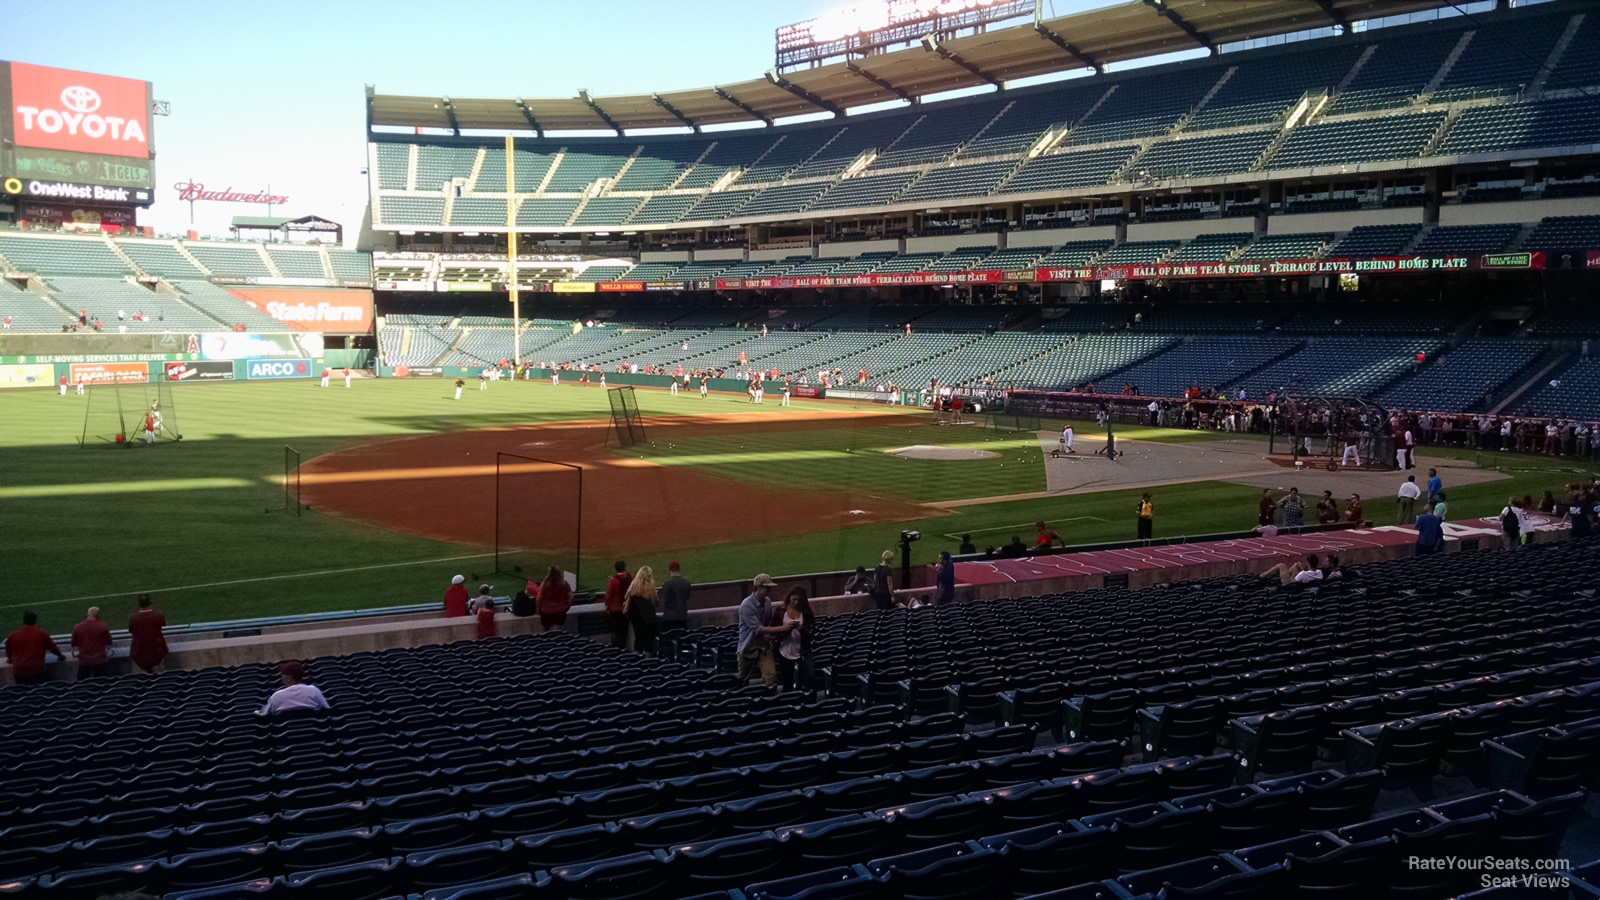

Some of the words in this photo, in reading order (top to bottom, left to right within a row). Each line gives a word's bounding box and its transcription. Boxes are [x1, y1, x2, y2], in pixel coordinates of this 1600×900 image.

[17, 106, 145, 142] TOYOTA
[29, 181, 92, 198] OneWest
[94, 185, 128, 201] Bank
[174, 182, 289, 204] Budweiser
[1049, 269, 1072, 278] VISIT
[1074, 269, 1092, 278] THE
[1133, 268, 1156, 276] HALL
[1158, 267, 1170, 276] OF
[1173, 266, 1198, 276] FAME
[1200, 265, 1226, 275] TEAM
[1228, 264, 1260, 274] STORE
[1270, 262, 1317, 273] TERRACE
[1319, 261, 1352, 272] LEVEL
[1356, 260, 1394, 270] BEHIND
[1398, 259, 1429, 269] HOME
[1432, 258, 1467, 268] PLATE
[760, 279, 772, 287] THE
[876, 276, 903, 284] TERRACE
[924, 275, 948, 283] BEHIND
[968, 274, 988, 282] PLATE
[36, 355, 84, 364] SELF-MOVING
[86, 354, 118, 362] SERVICES
[252, 362, 294, 376] ARCO
[954, 388, 970, 396] MLB
